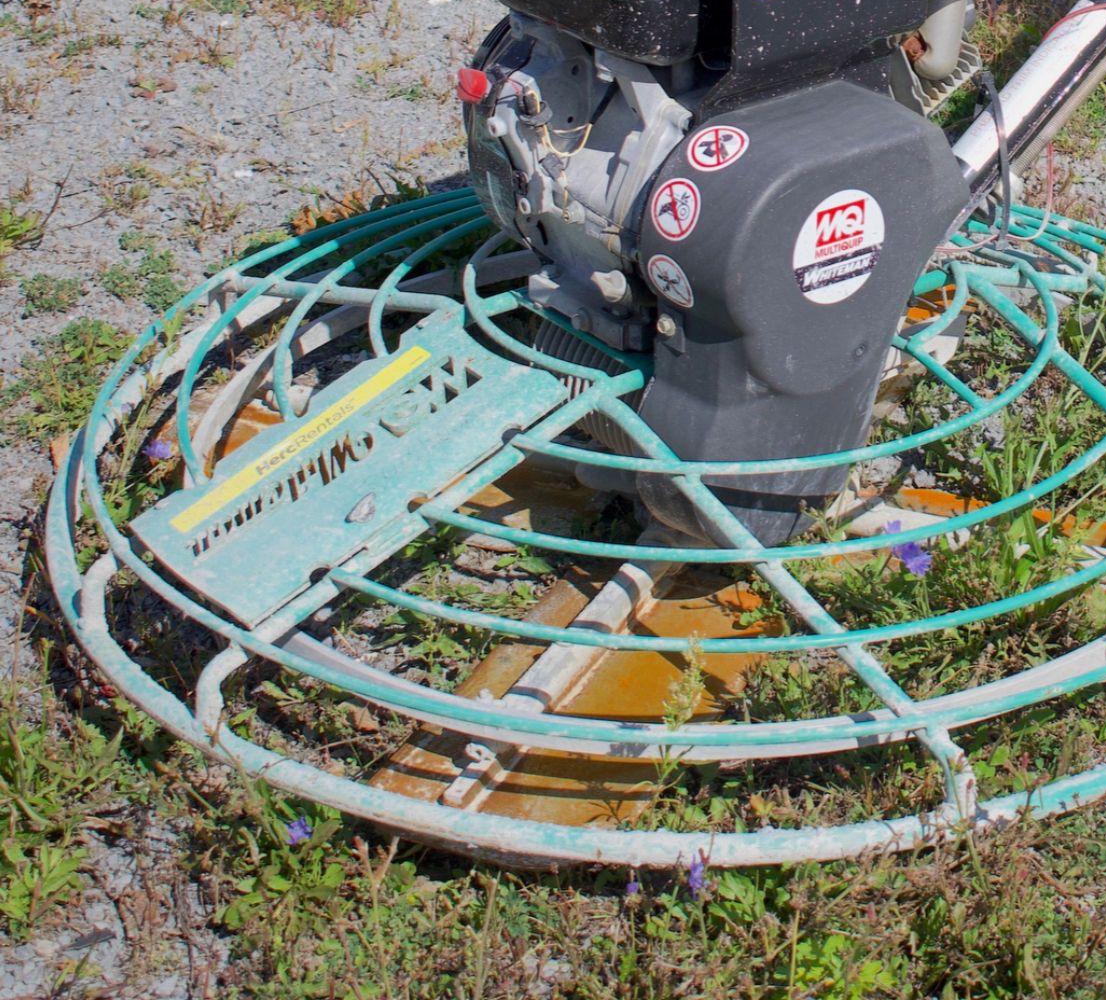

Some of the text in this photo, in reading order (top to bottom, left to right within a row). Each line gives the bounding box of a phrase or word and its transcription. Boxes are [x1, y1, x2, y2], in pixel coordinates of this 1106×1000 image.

[816, 205, 864, 243] MQ
[815, 237, 864, 259] MULTIQUIP
[803, 253, 872, 288] WHITEMAN
